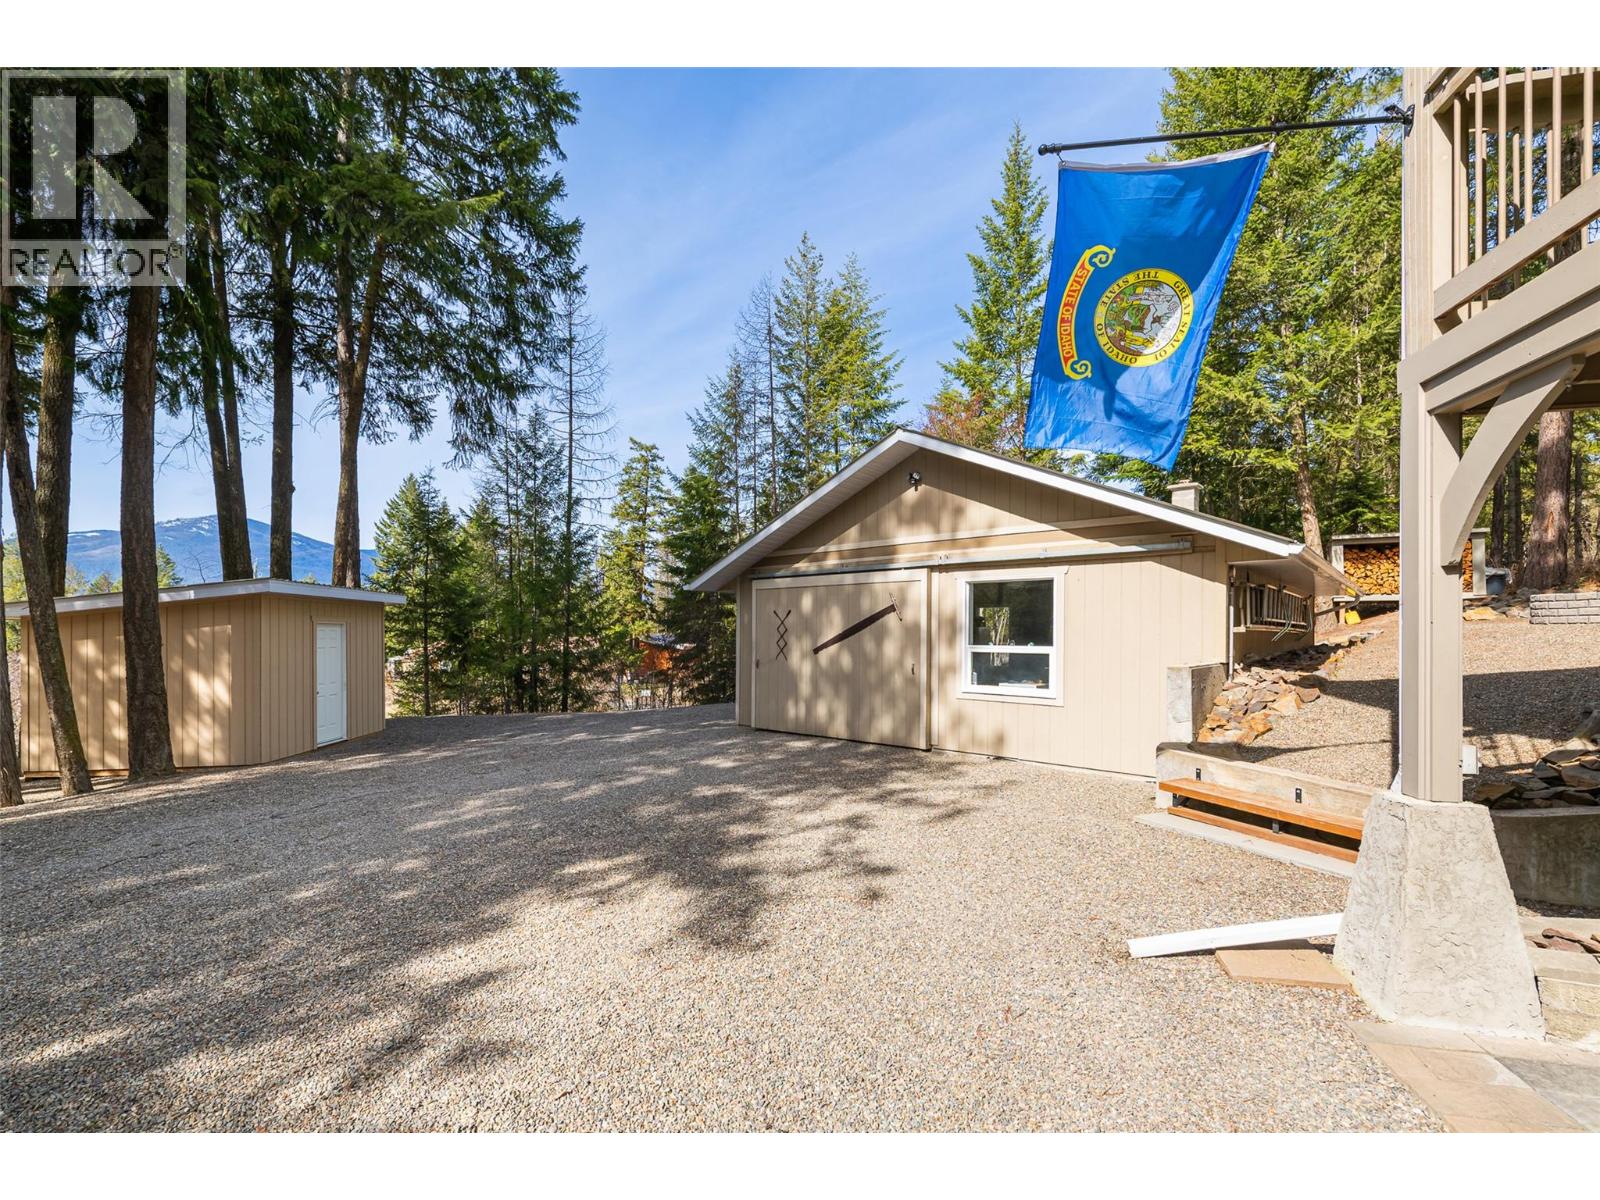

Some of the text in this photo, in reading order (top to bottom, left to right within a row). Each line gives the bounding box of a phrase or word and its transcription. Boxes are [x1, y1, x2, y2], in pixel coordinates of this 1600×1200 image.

[1101, 277, 1130, 308] STATE
[1173, 280, 1191, 316] GREAT
[1060, 268, 1087, 357] STATE OF IDAHO
[1103, 342, 1138, 364] IDAHO
